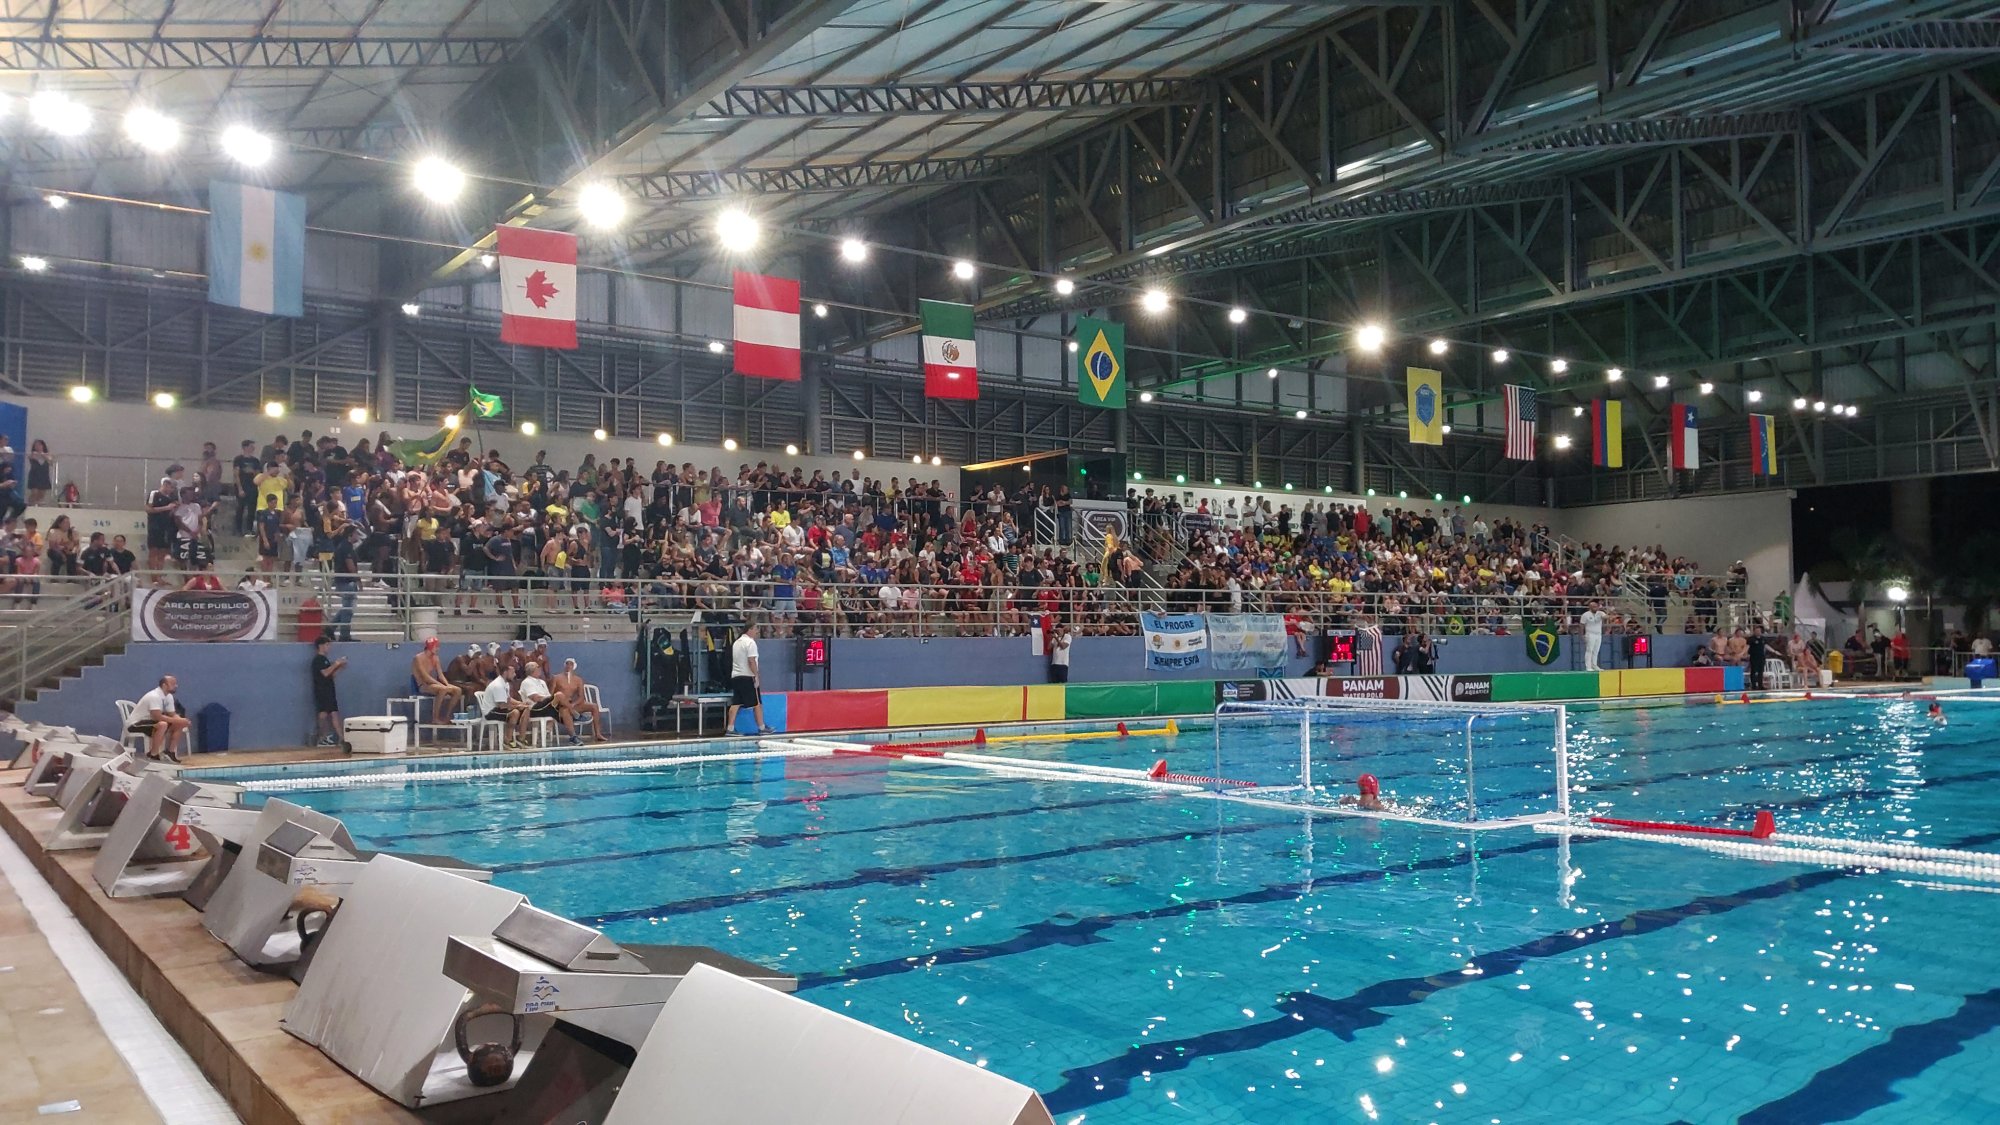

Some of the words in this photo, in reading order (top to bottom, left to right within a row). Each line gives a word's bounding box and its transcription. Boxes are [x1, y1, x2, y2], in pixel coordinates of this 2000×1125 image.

[1154, 620, 1164, 629] EL
[1165, 619, 1194, 630] PROGRE
[806, 648, 823, 661] 30
[1342, 680, 1384, 691] PANAM
[1465, 681, 1489, 690] PANAM
[165, 823, 191, 851] 4
